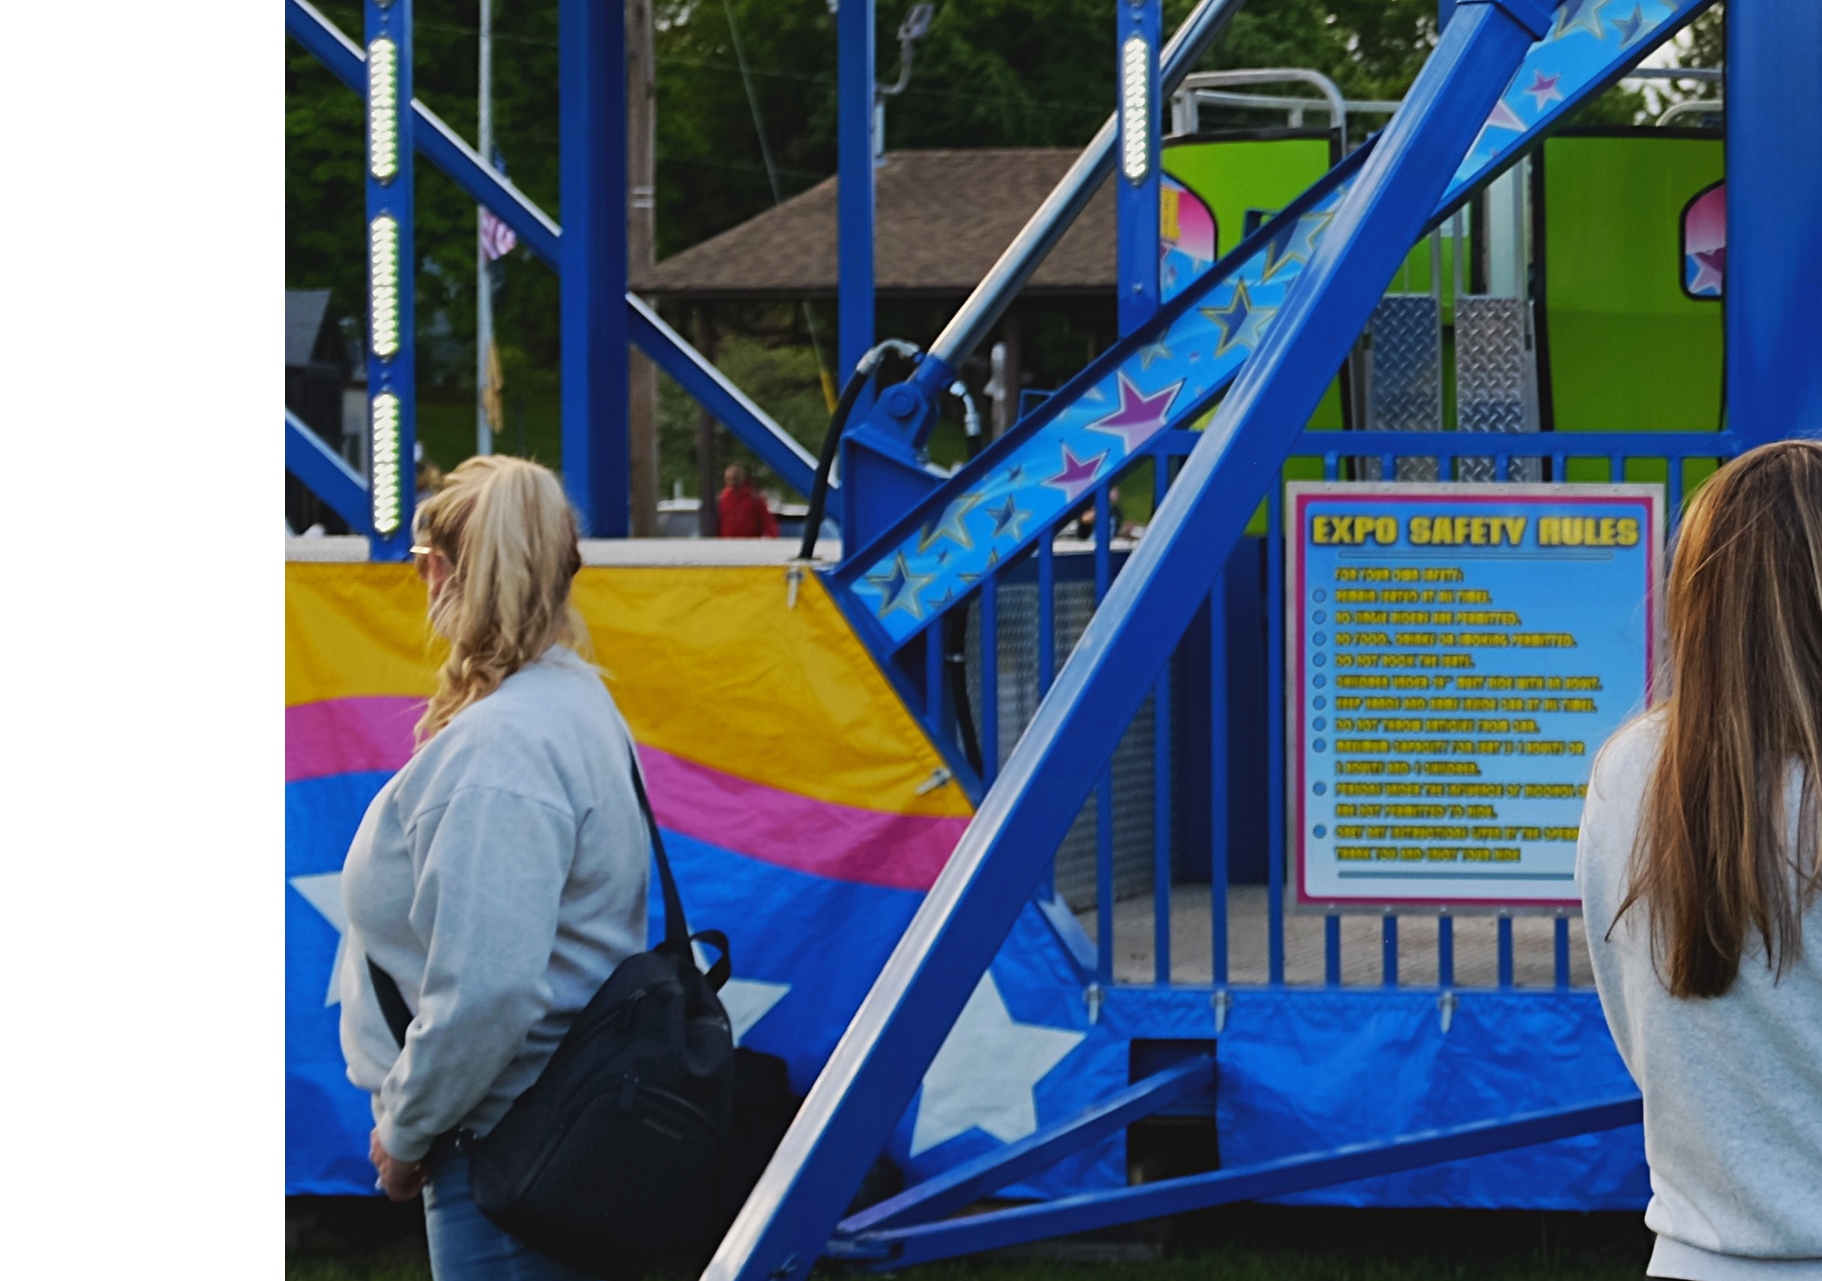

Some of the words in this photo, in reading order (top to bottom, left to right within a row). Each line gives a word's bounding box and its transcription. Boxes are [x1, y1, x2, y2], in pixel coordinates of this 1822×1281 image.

[1312, 515, 1398, 545] EXPO
[1408, 515, 1527, 546] SAFETY
[1537, 516, 1640, 547] RULES
